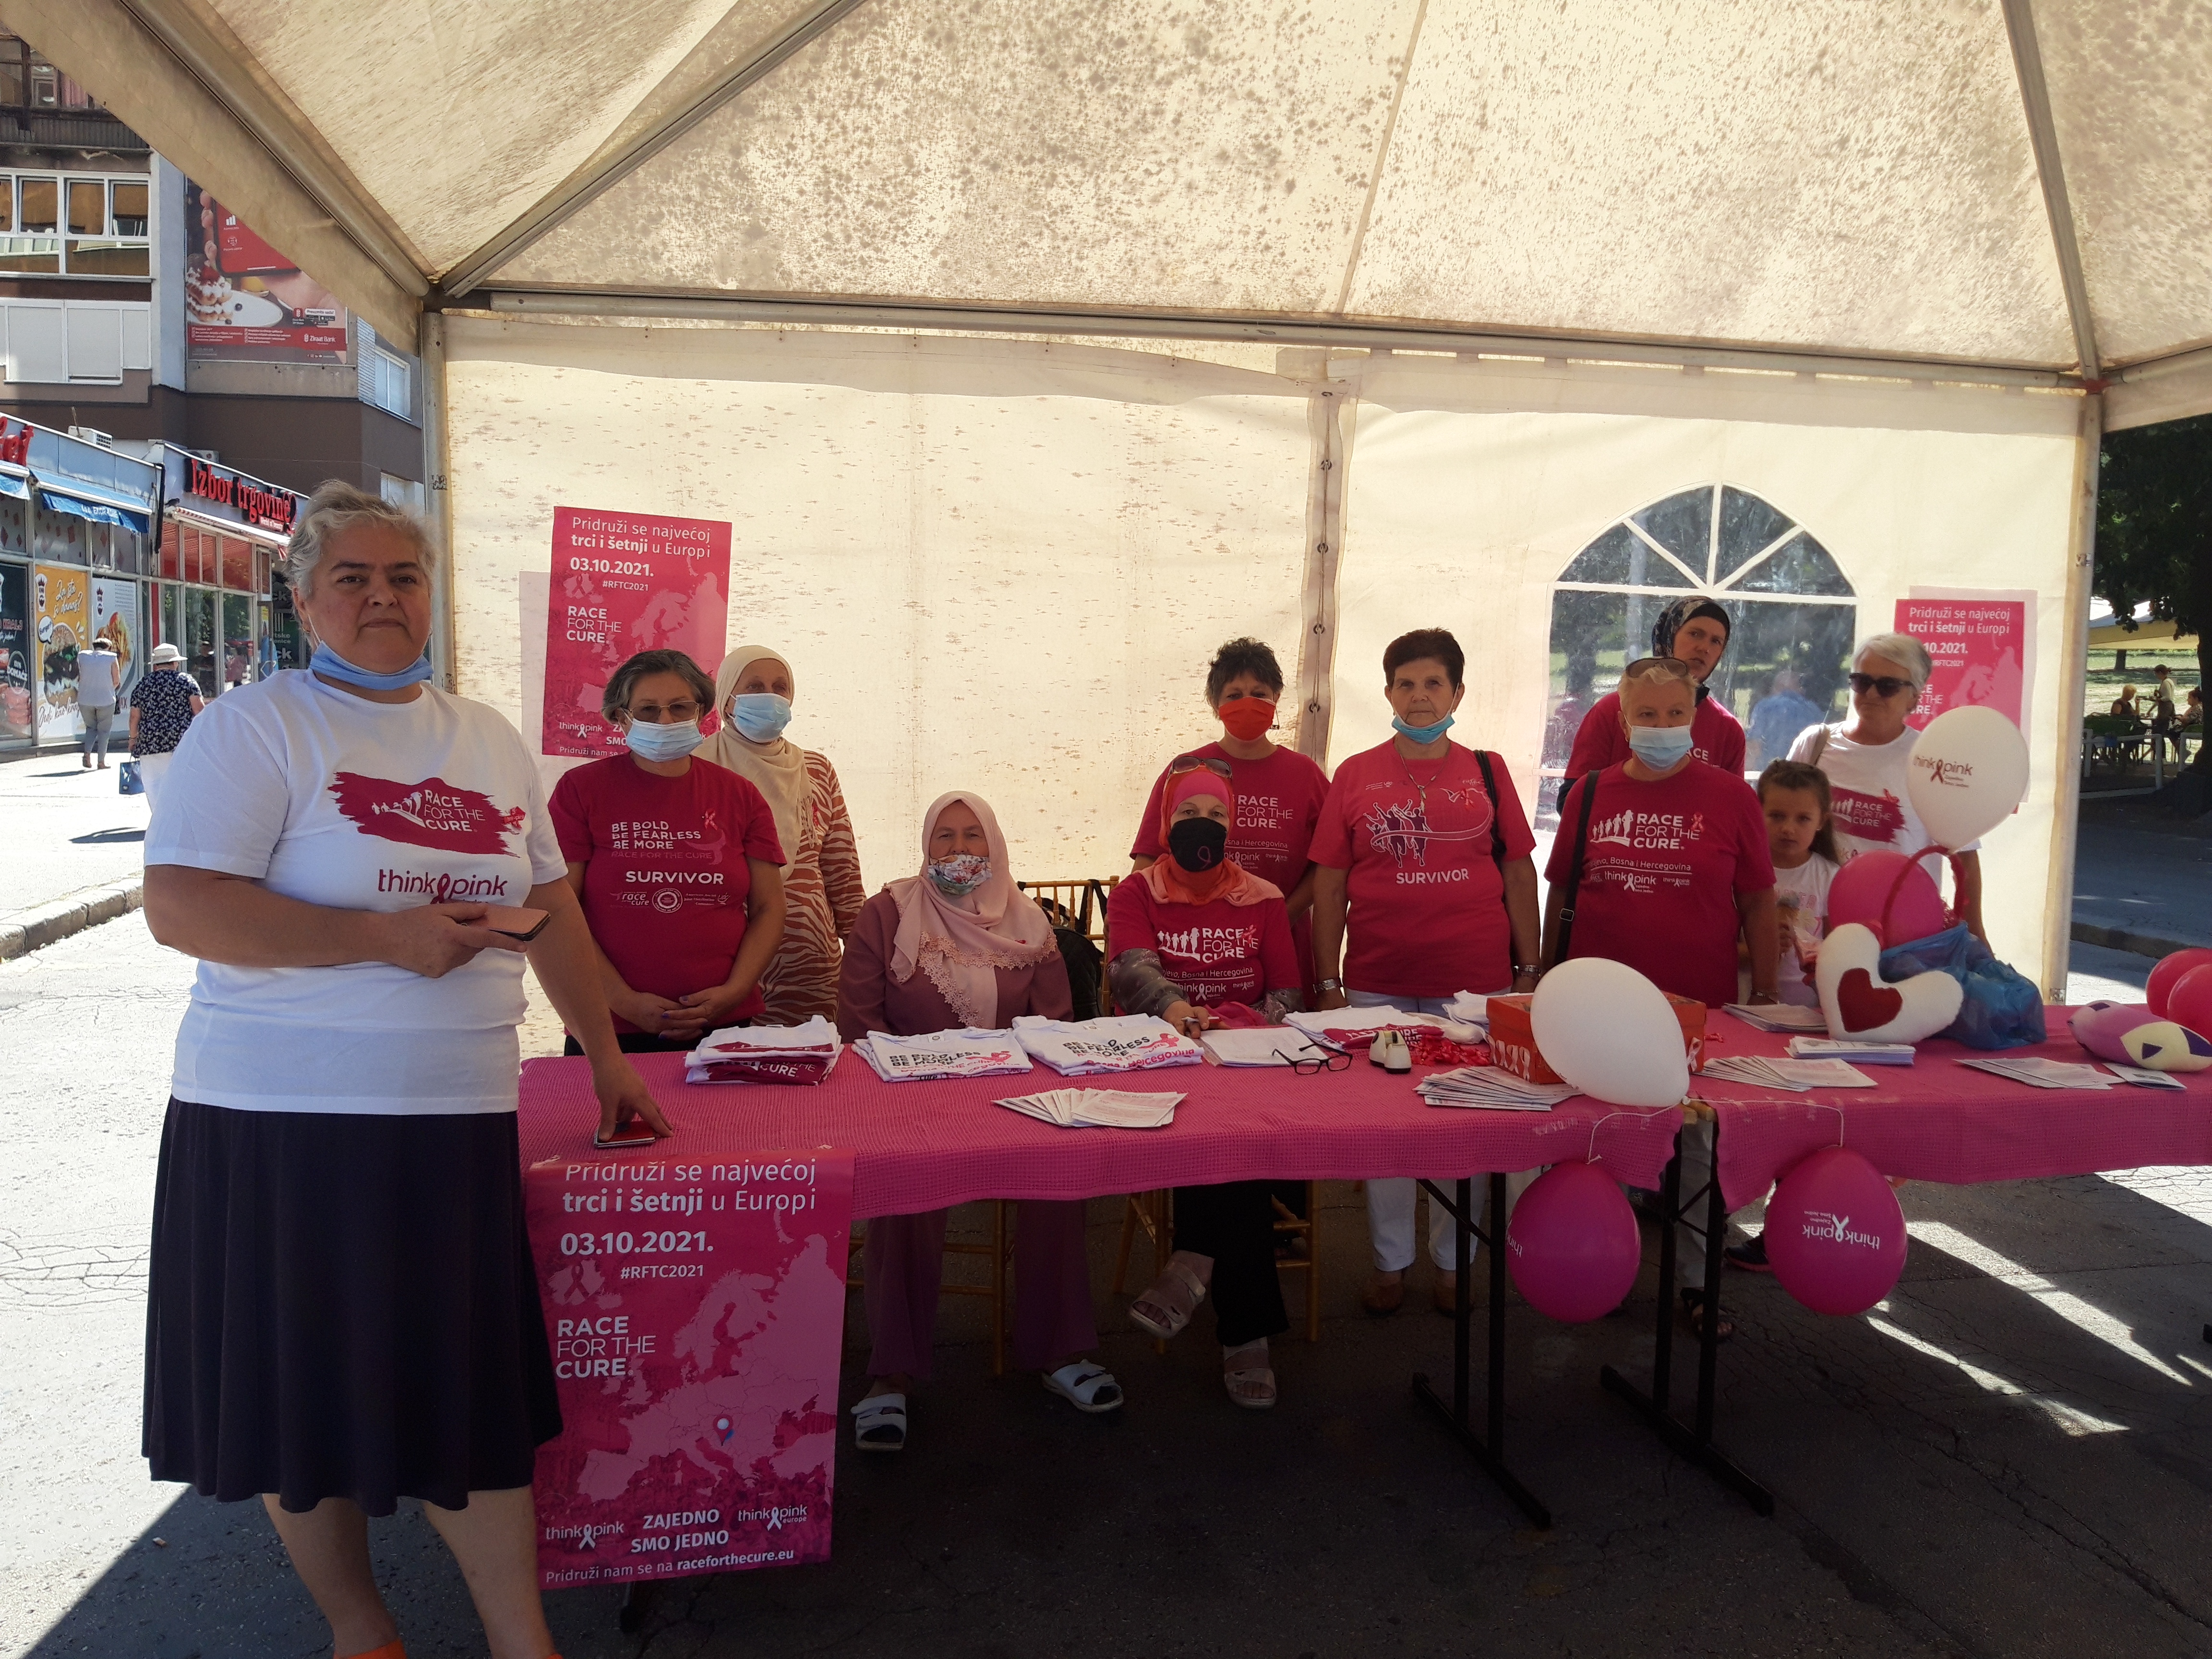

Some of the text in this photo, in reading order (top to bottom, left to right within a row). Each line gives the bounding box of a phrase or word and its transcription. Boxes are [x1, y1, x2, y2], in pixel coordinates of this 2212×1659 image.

[192, 459, 291, 523] Izbor trgovine
[572, 517, 710, 544] Pridruži se najvećoj
[571, 534, 710, 560] trci i šetnji u Europi
[570, 557, 654, 577] 03.10.2021.
[602, 580, 649, 592] #RFTC2021
[567, 606, 608, 619] RACE
[1909, 607, 2010, 621] Pridruži se najvećoj
[567, 618, 622, 633] FOR THE
[1908, 621, 2010, 636] trci i šetnji u Europi
[559, 721, 580, 731] think
[585, 725, 603, 734] pink
[560, 746, 589, 756] Pridruži
[1944, 761, 1973, 776] pink
[424, 789, 464, 808] RACE
[1237, 794, 1278, 807] RACE
[424, 804, 486, 821] FOR THE
[1237, 806, 1294, 820] FOR THE
[1855, 801, 1883, 811] RACE
[1636, 813, 1683, 827] RACE
[1854, 808, 1892, 821] FOR THE
[612, 821, 669, 832] BE BOLD
[1853, 817, 1880, 827] CURE
[634, 830, 701, 840] FEARLESS
[1635, 826, 1700, 840] FOR THE
[613, 840, 674, 849] BE MORE
[1244, 840, 1288, 849] Hercegovina
[1241, 852, 1260, 863] pink
[1610, 857, 1634, 866] Bosna
[1640, 860, 1691, 871] Hercegovina
[625, 871, 724, 885] SURVIVOR
[1396, 868, 1469, 884] SURVIVOR
[1604, 870, 1657, 885] think pink
[378, 868, 508, 899] think pink
[1202, 928, 1244, 940] RACE
[1203, 938, 1259, 952] FOR THE
[1210, 967, 1253, 977] Hercegovina
[1205, 983, 1227, 995] pink
[565, 1158, 817, 1186] Pridruži se najvećoj
[563, 1188, 817, 1216] trci i šetnji u Europi
[560, 1230, 714, 1256] 03.10.2021.
[1802, 1224, 1880, 1250] think pink
[621, 1264, 704, 1280] #RFTC2021
[557, 1316, 629, 1337] RACE
[557, 1335, 657, 1358] FOR THE
[643, 1508, 720, 1530] ZAJEDNO
[738, 1503, 808, 1525] think pink
[782, 1515, 807, 1524] europe
[545, 1520, 624, 1541] think pink
[630, 1529, 730, 1554] SMO JEDNO
[546, 1549, 795, 1583] Pridruži nam se na raceforthecure.eu
